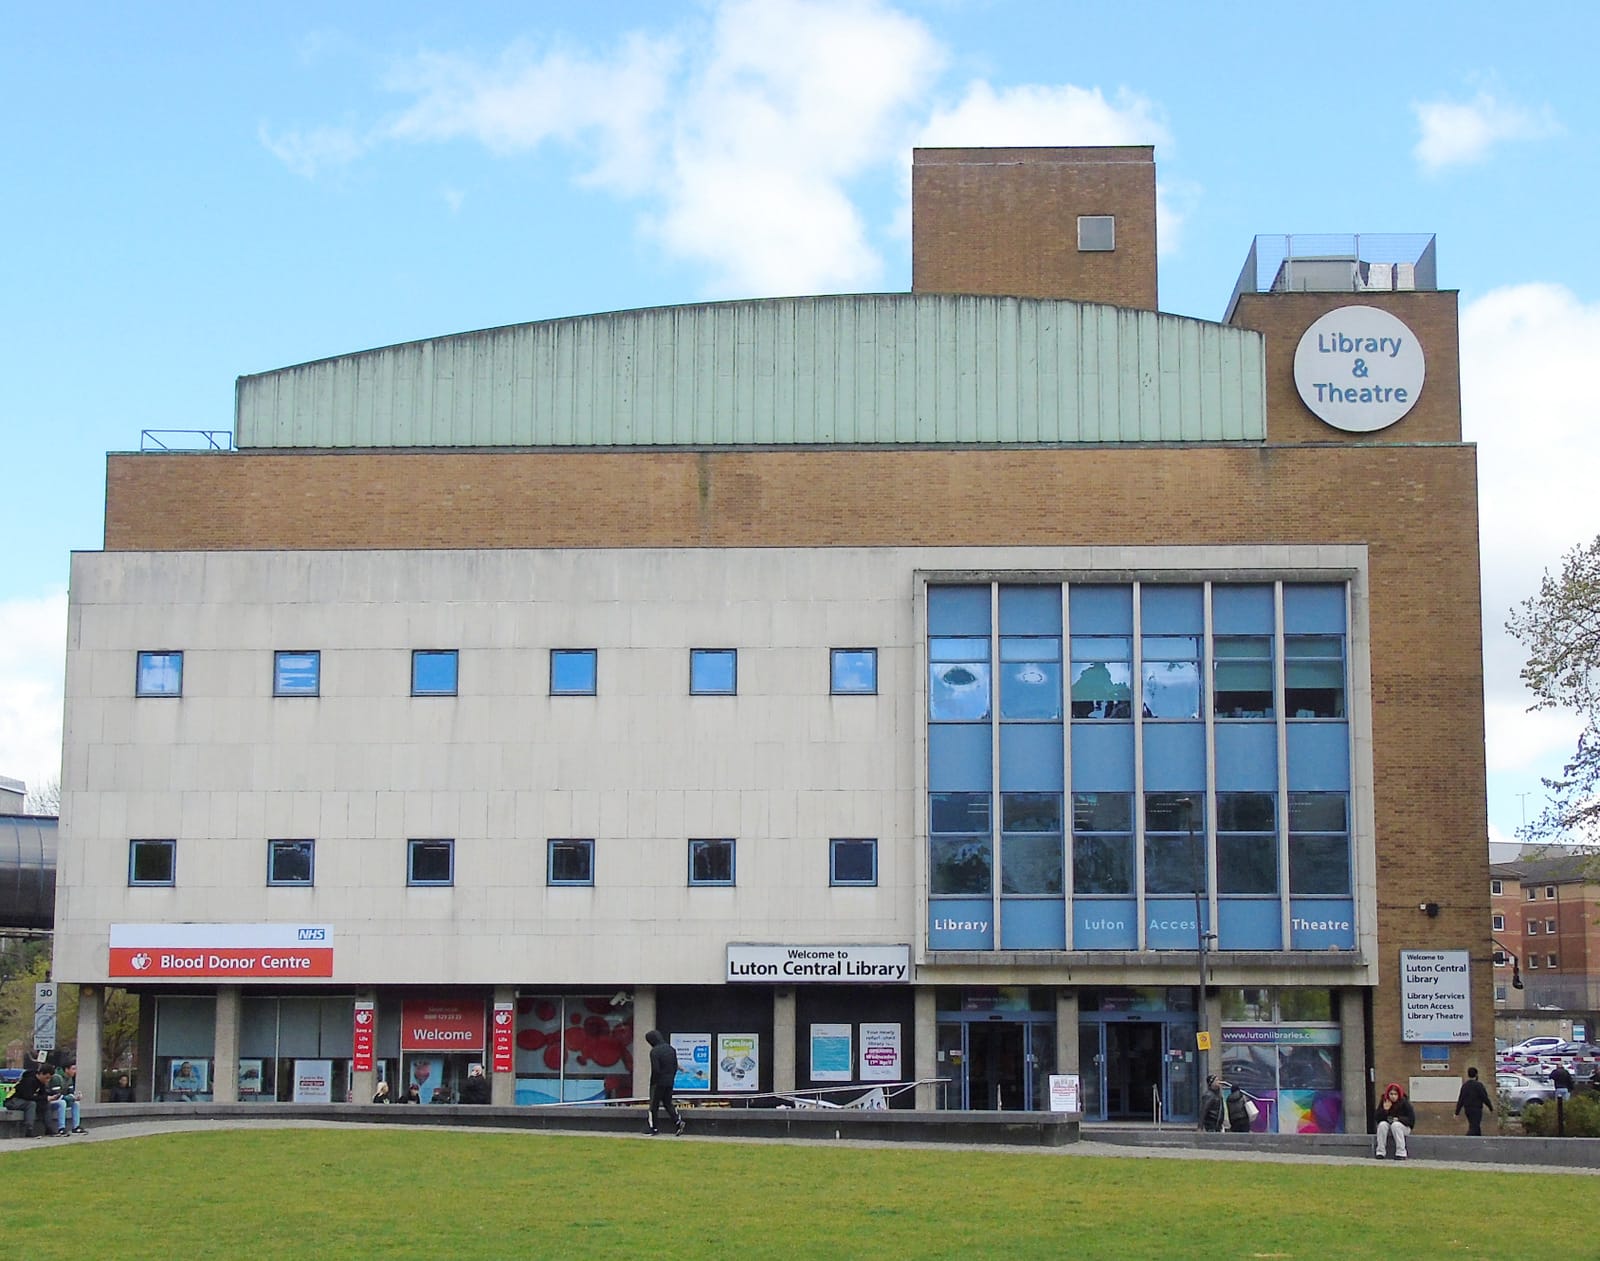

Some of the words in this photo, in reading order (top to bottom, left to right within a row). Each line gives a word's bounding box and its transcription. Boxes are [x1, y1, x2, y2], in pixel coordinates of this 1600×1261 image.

[1318, 332, 1402, 358] Library
[1352, 358, 1369, 378] &
[1312, 382, 1408, 403] Theatre
[934, 919, 988, 933] Library
[1084, 919, 1125, 930] Luton
[1291, 919, 1349, 930] Theatre
[299, 929, 325, 940] NHS
[787, 950, 835, 959] Welcome
[837, 950, 848, 959] to
[160, 954, 204, 969] Blood
[209, 955, 256, 969] Donor
[261, 955, 311, 969] Centre
[730, 961, 778, 976] Luton
[782, 961, 841, 976] Central
[846, 961, 906, 979] Library
[1406, 964, 1432, 972] Luton
[1434, 964, 1466, 972] Central
[1406, 975, 1439, 984] Library
[40, 989, 53, 997] 30
[1407, 992, 1433, 1000] Library
[1407, 1012, 1433, 1020] Library
[413, 1028, 473, 1040] Welcome
